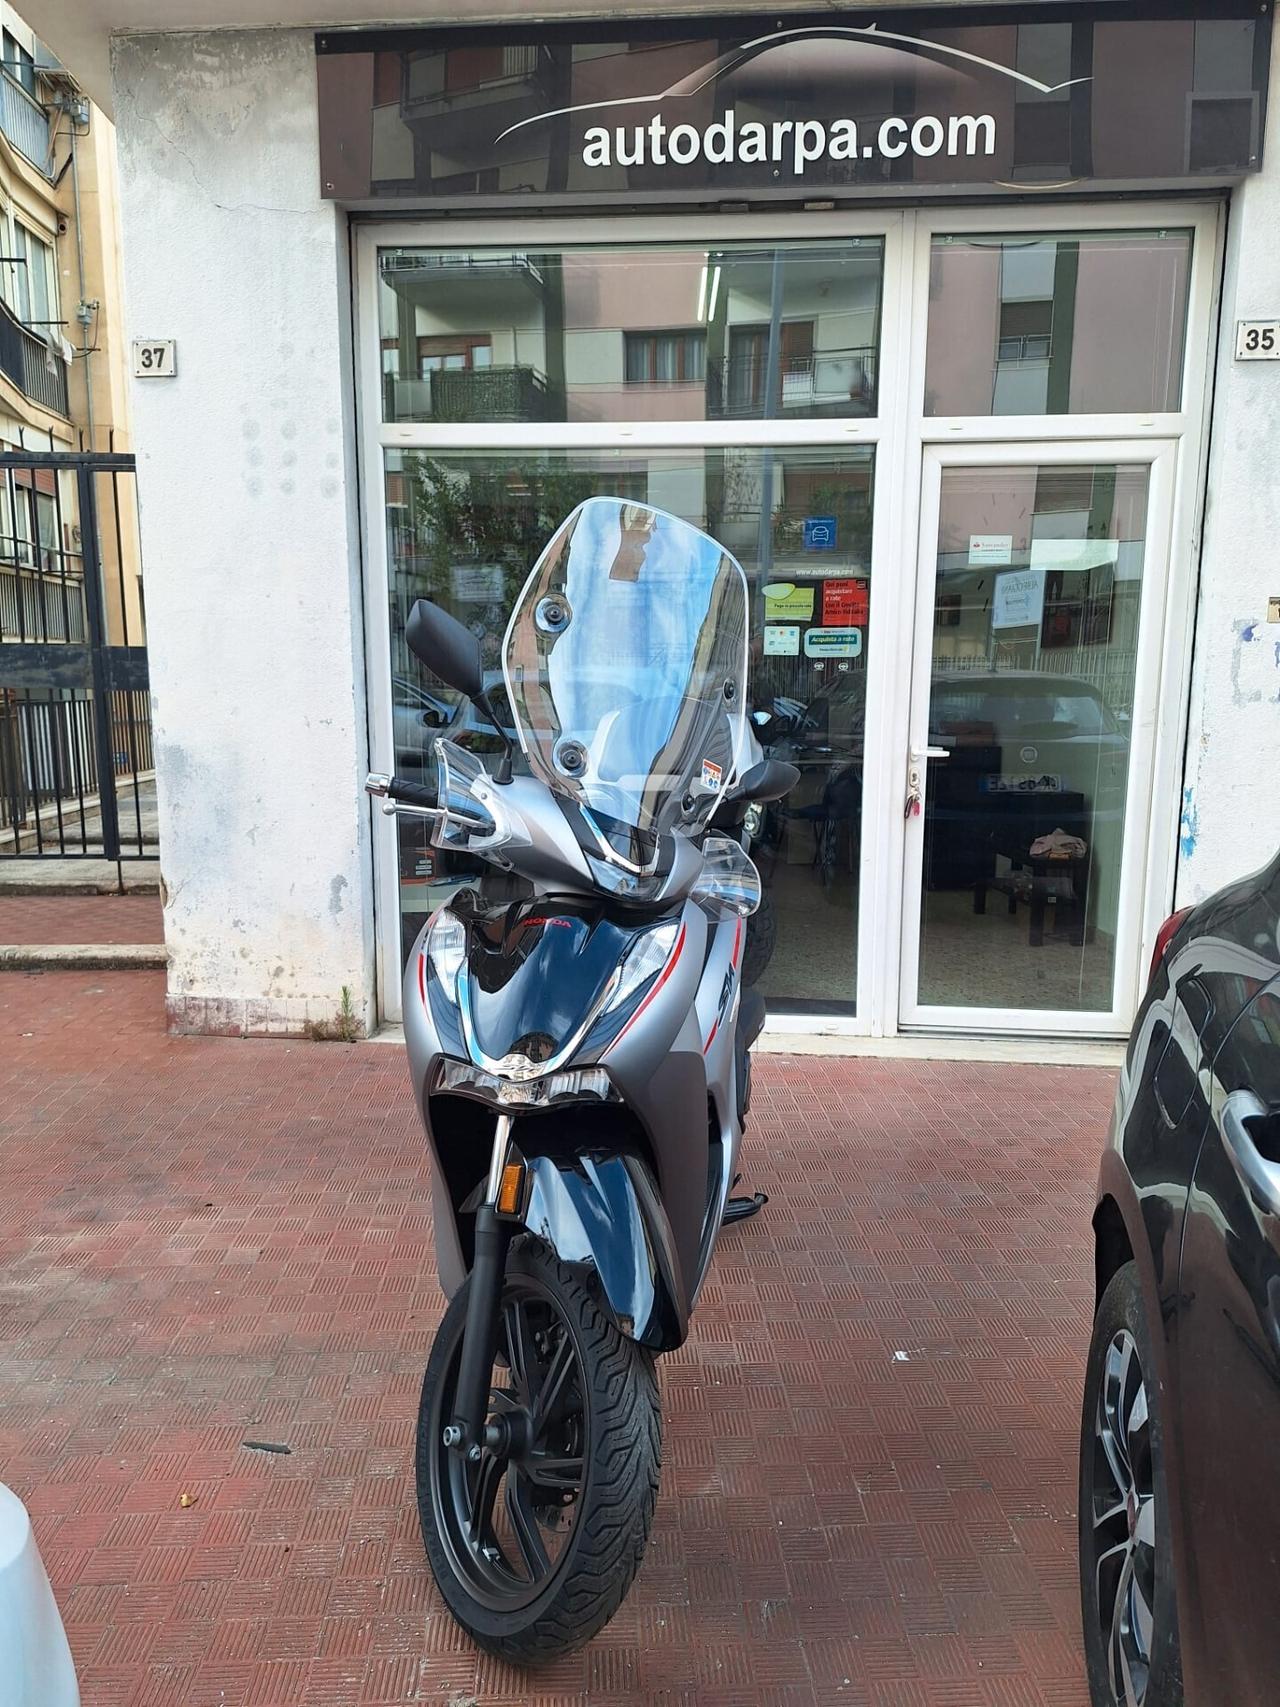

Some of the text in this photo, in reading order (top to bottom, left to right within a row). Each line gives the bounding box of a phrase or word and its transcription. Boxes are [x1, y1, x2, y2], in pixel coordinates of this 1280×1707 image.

[582, 109, 997, 175] autodarpa.com
[1246, 328, 1275, 350] 35
[141, 347, 165, 368] 37
[524, 917, 572, 928] HONDA
